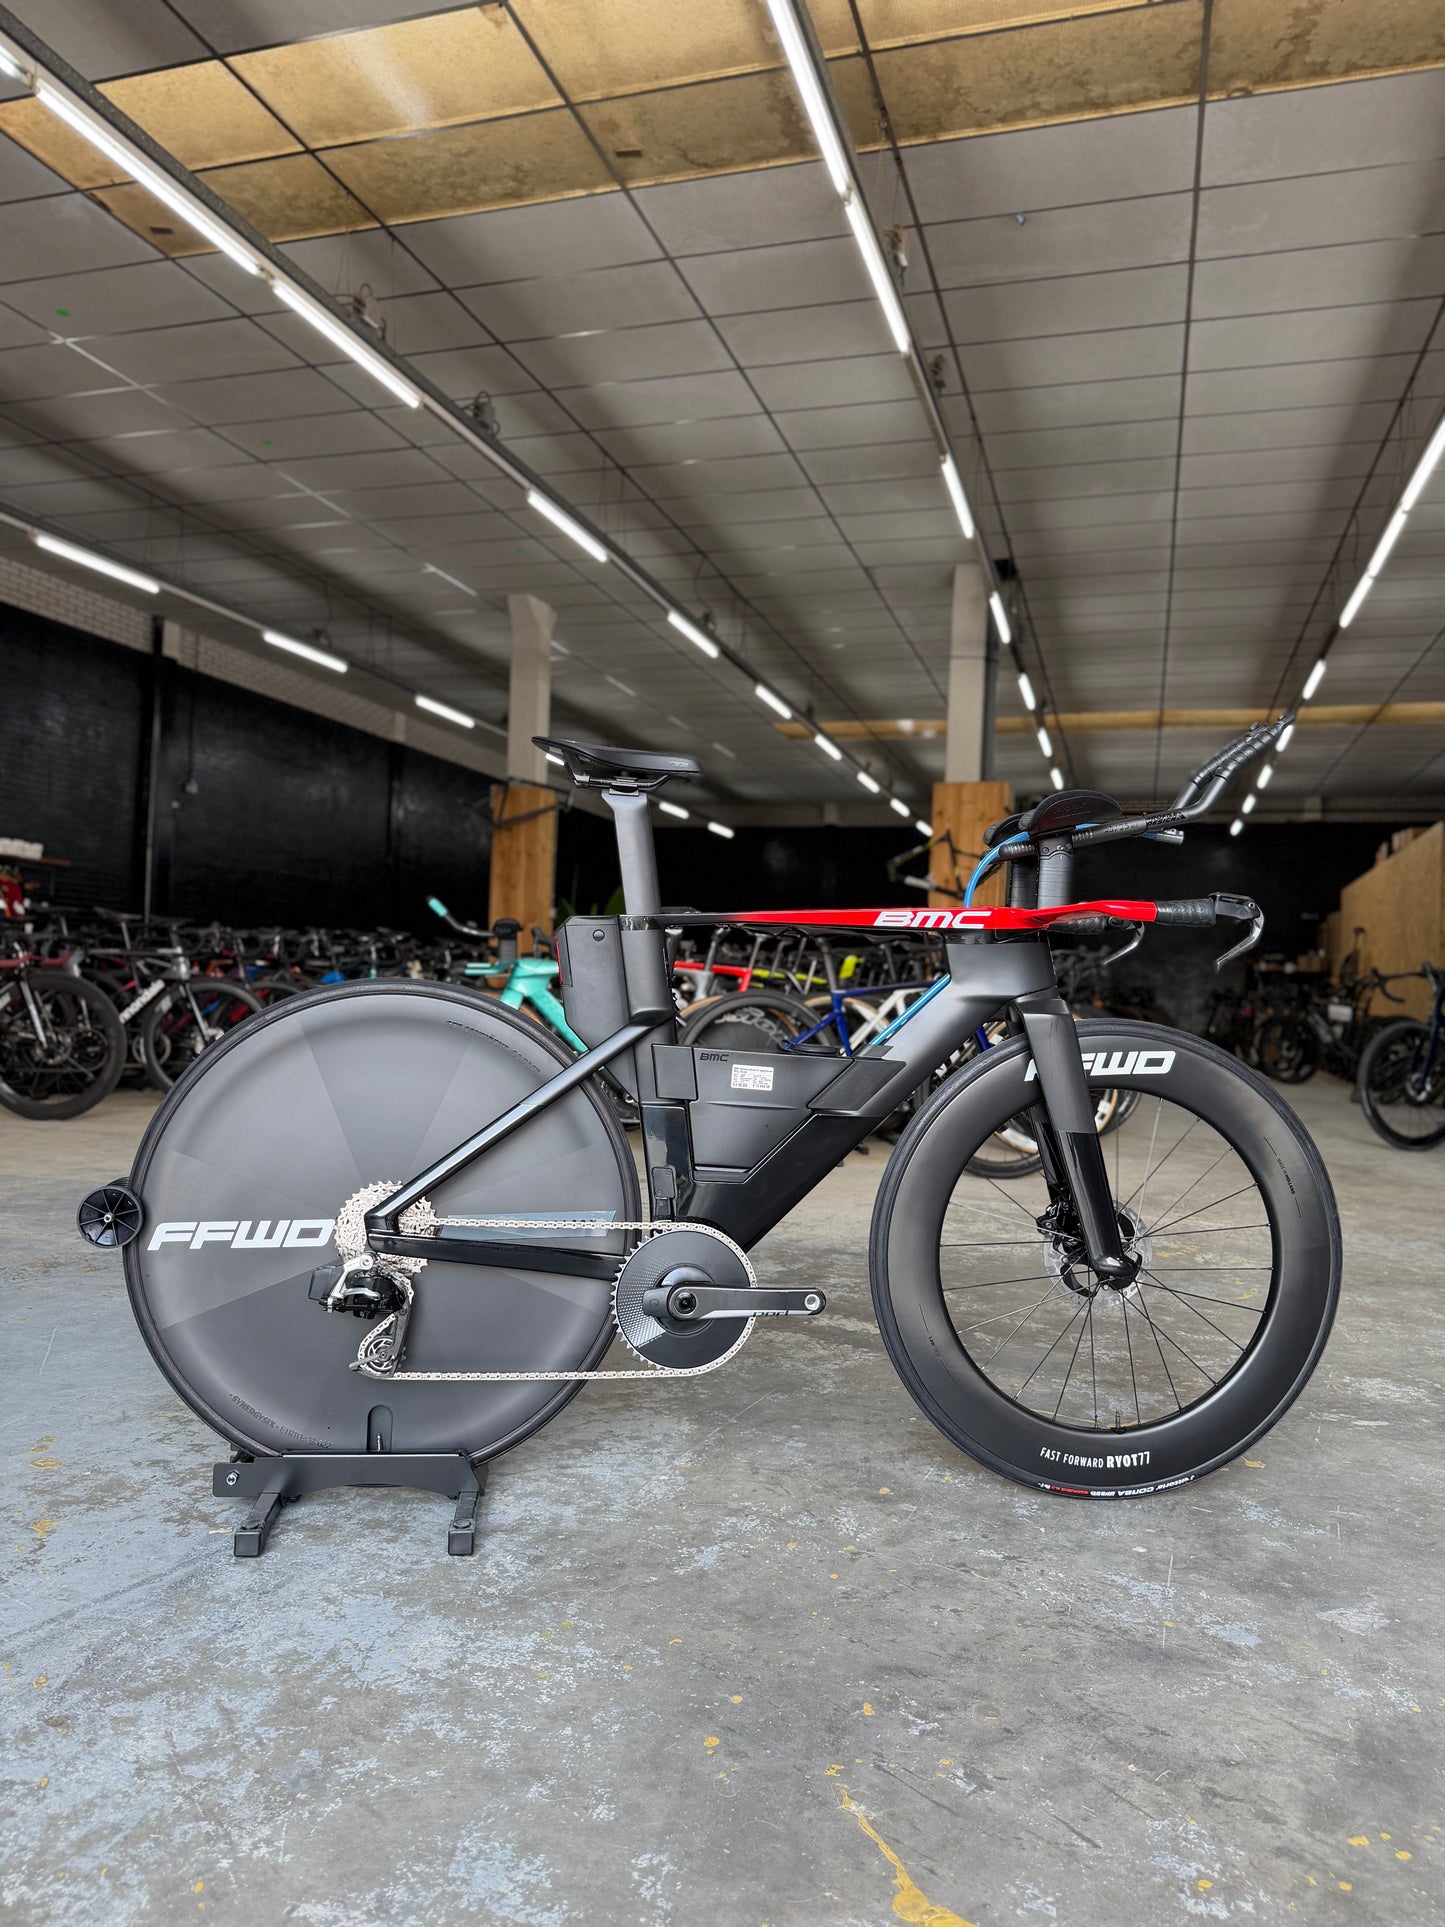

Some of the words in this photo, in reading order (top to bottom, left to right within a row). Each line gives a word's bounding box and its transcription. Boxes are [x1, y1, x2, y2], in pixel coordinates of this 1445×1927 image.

[873, 911, 992, 929] BMC
[700, 1053, 729, 1062] BMC
[147, 1219, 335, 1250] FFWD
[231, 1395, 277, 1429] SYNERGYSIX
[1040, 1447, 1061, 1462] FAST
[1063, 1453, 1104, 1468] FORWARD
[1106, 1450, 1150, 1468] RYOT77
[1117, 1486, 1154, 1497] CORSA
